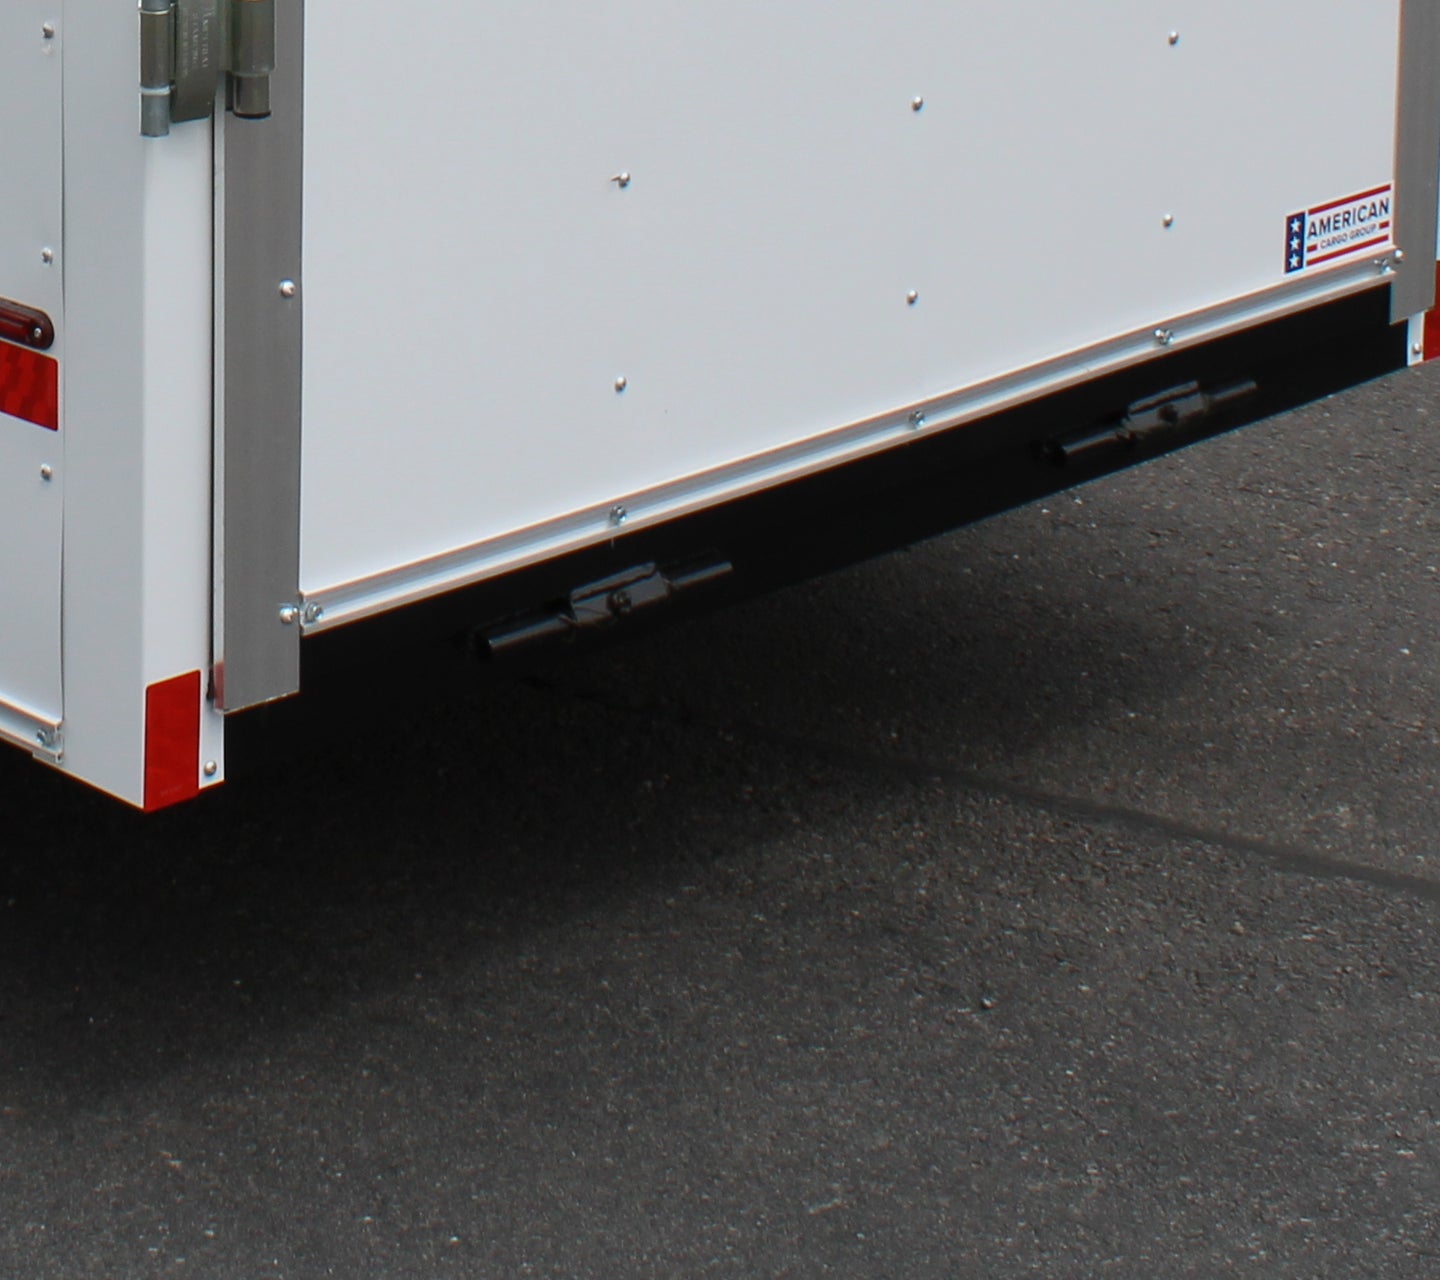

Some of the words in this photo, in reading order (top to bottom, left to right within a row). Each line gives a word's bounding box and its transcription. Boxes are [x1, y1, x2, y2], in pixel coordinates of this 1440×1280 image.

[1307, 197, 1390, 239] AMERICAN
[1320, 233, 1348, 250] CARGO
[1350, 224, 1377, 241] GROUP
